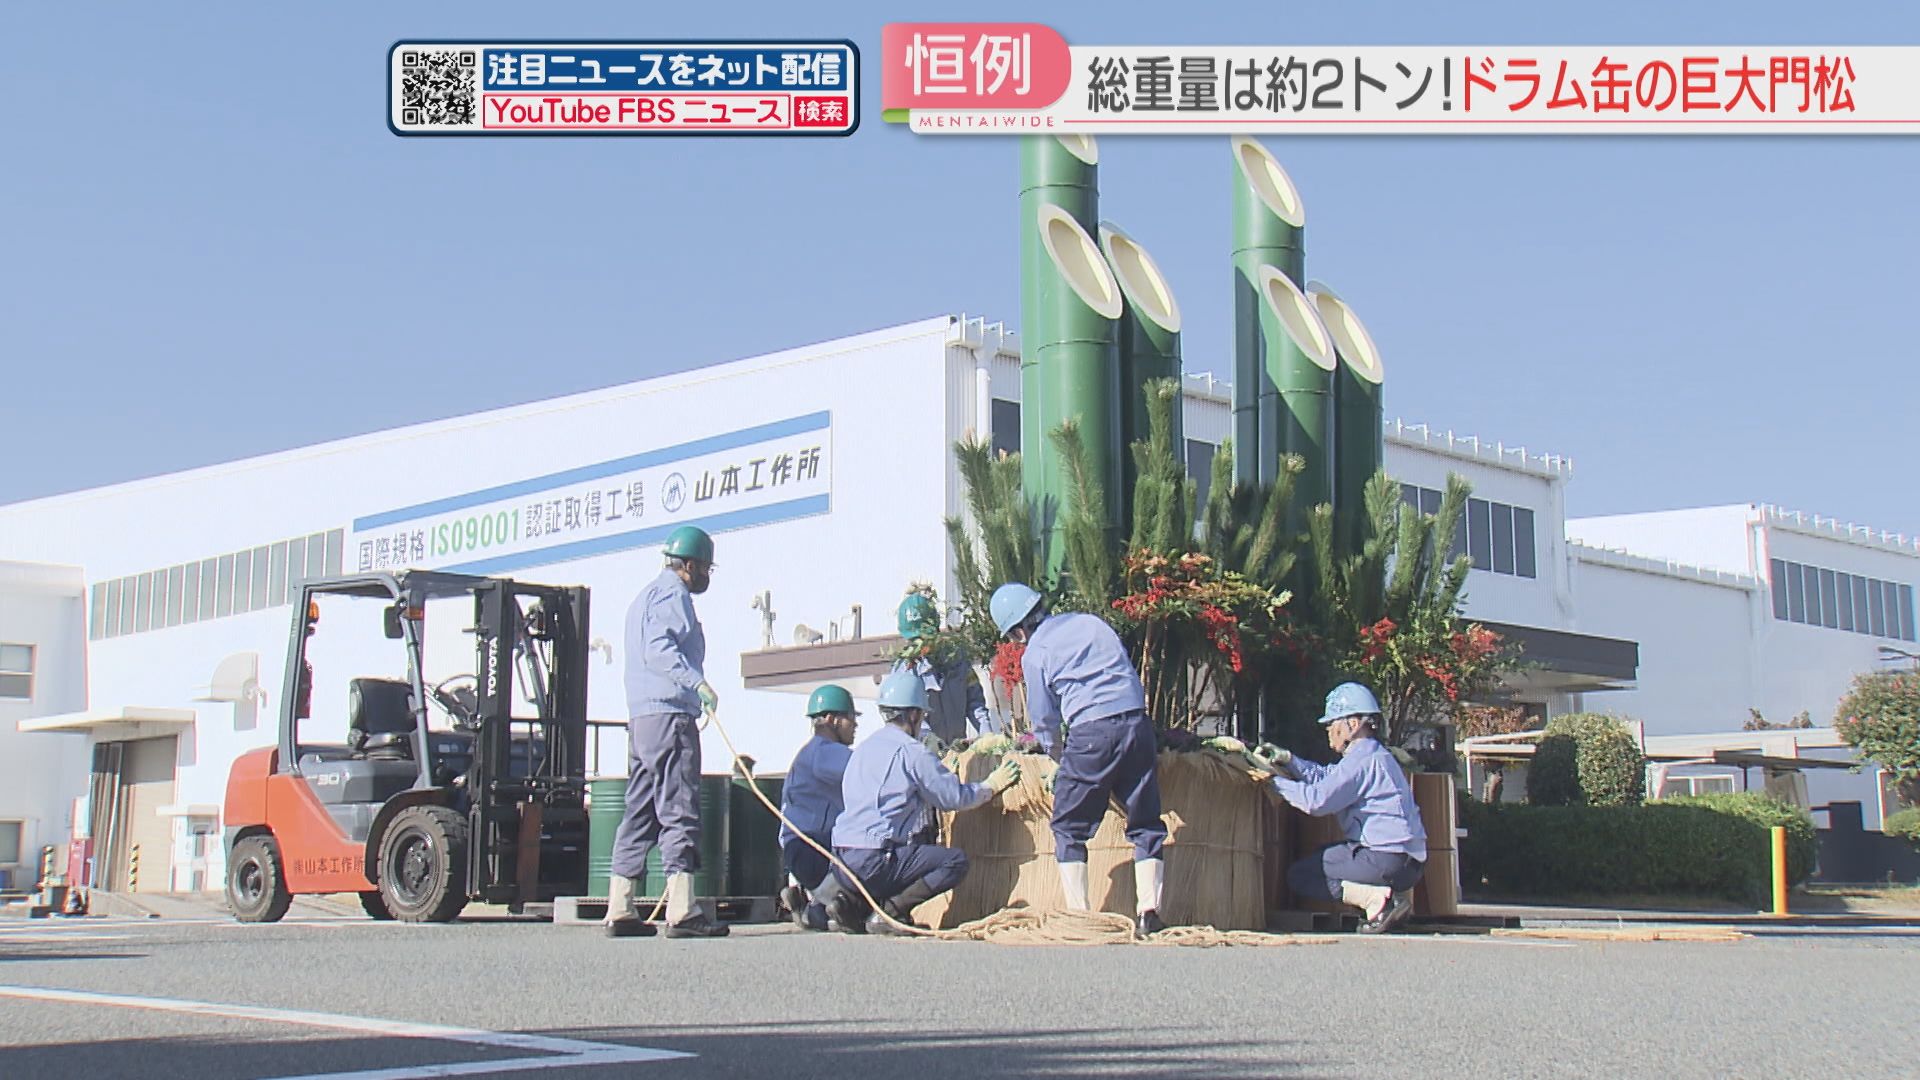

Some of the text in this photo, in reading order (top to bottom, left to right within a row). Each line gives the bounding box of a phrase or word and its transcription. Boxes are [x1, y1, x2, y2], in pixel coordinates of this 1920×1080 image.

[694, 445, 822, 503] 山本工作所
[487, 636, 498, 697] TOYOTA
